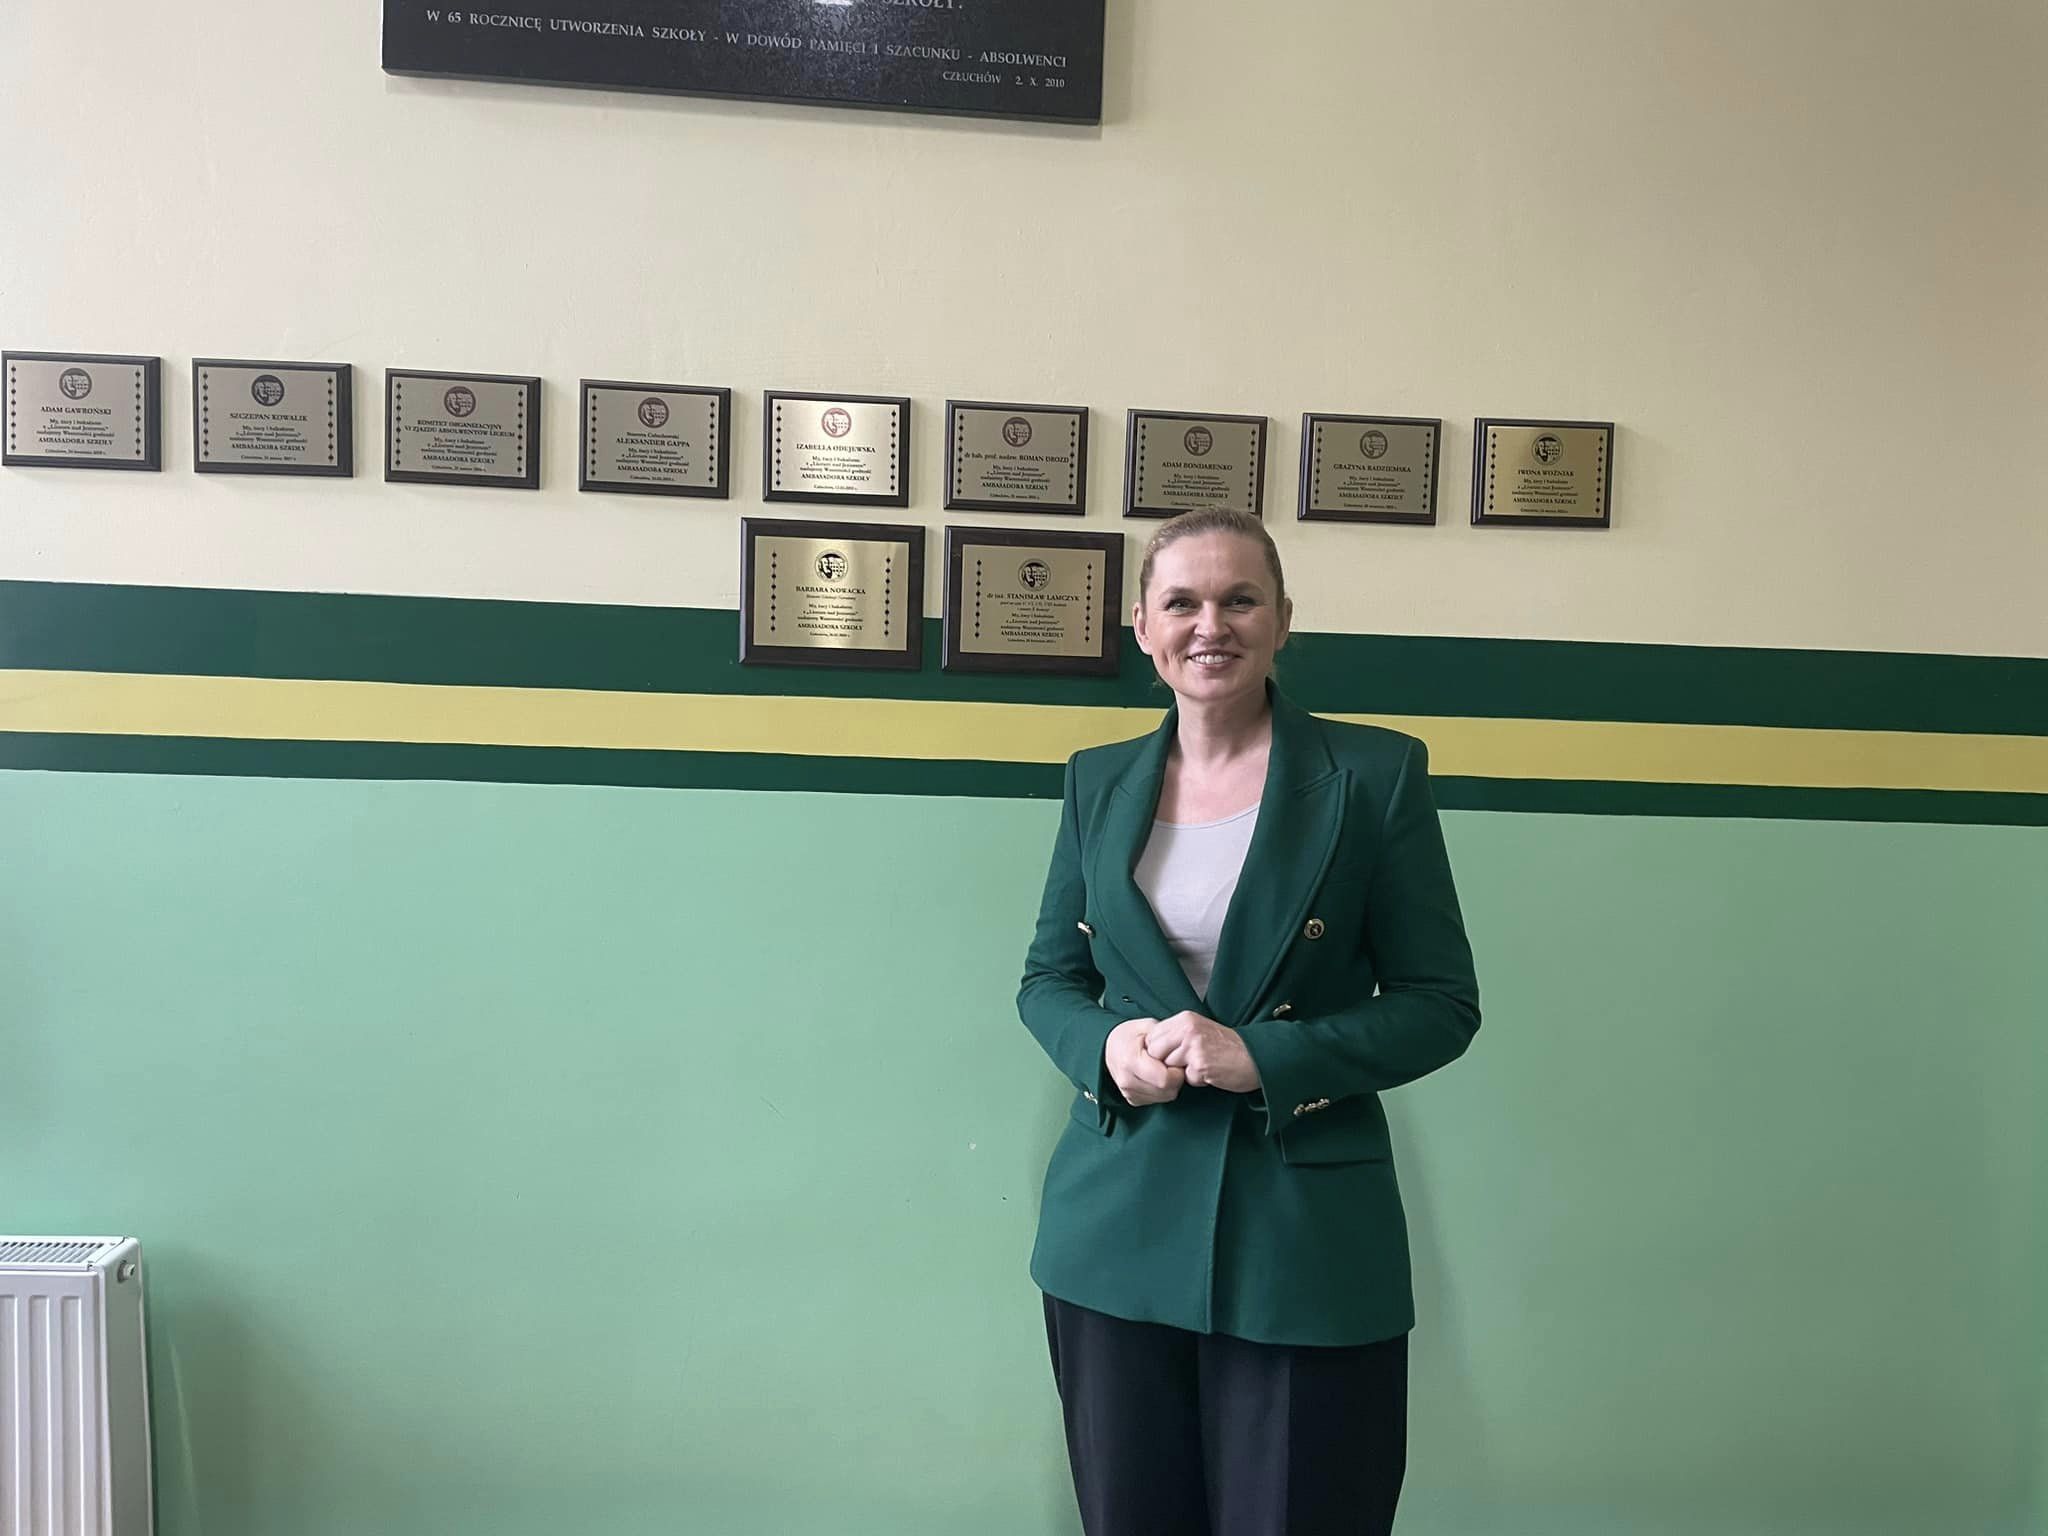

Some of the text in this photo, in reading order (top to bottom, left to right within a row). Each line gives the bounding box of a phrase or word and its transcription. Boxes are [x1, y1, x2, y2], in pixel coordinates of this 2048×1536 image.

[426, 9, 440, 21] W
[447, 12, 462, 23] 65
[469, 12, 543, 31] ROCZNICĘ
[549, 18, 645, 37] UTWORZENIA
[652, 26, 706, 42] SZKOŁY
[726, 32, 740, 45] W
[747, 32, 802, 49] DOWÓD
[810, 39, 866, 55] PAMIĘCI
[873, 43, 878, 55] I
[886, 44, 960, 61] SZACUNKU
[979, 50, 1067, 68] ABSOLWENCI
[942, 71, 1000, 84] CZŁUCHÓW
[1045, 78, 1065, 88] 2010
